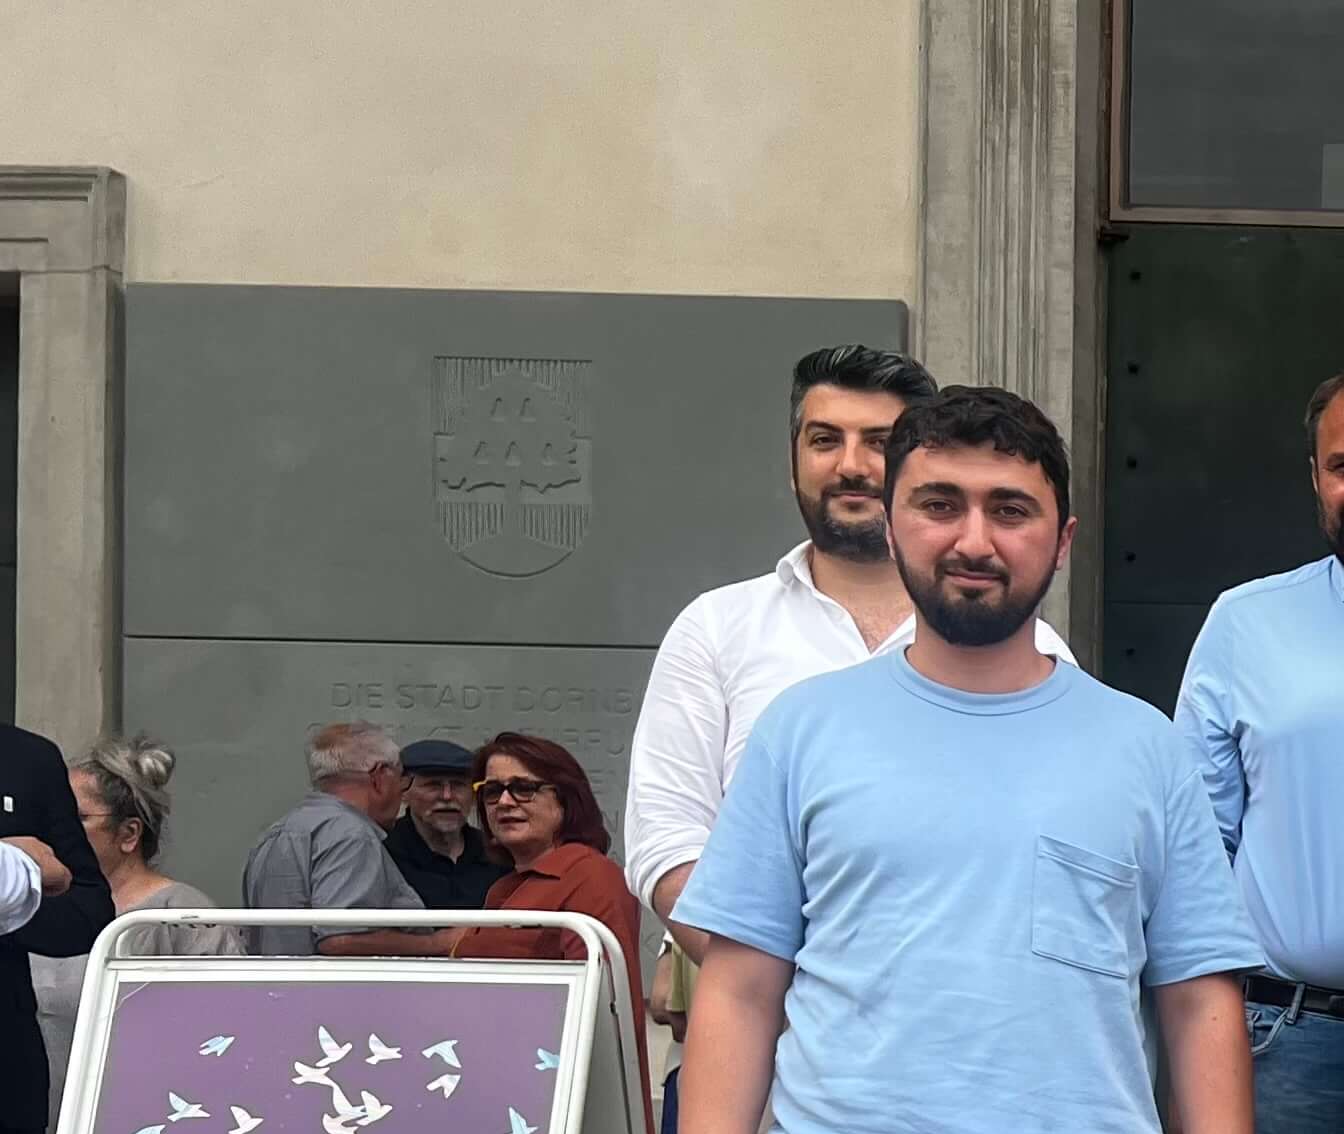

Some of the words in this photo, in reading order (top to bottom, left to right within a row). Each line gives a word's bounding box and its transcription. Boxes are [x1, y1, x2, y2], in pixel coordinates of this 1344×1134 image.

[330, 682, 385, 711] DIE
[395, 682, 505, 712] STADT
[512, 687, 634, 715] DORNB
